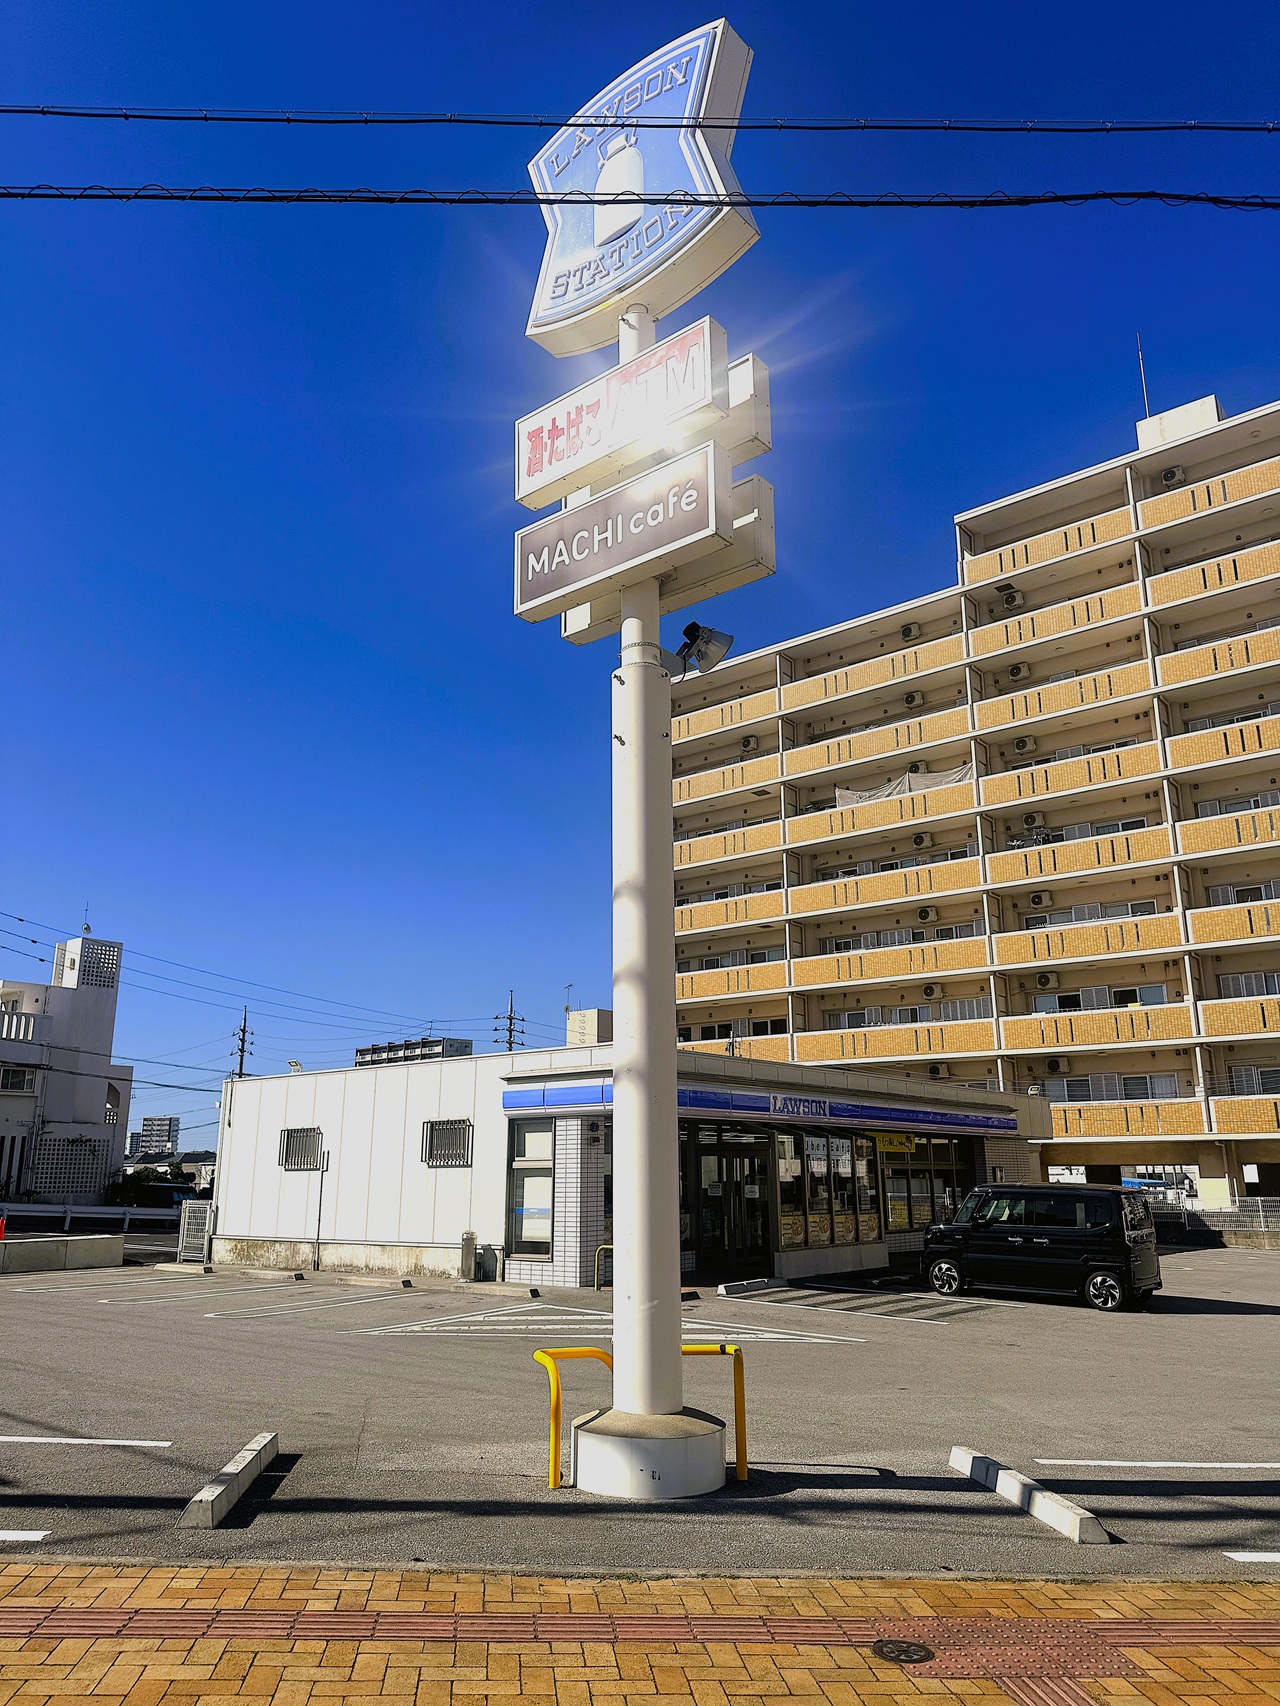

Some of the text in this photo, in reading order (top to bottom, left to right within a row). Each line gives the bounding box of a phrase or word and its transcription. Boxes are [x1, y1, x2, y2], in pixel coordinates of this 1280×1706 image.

[550, 55, 693, 178] LAWSON
[550, 192, 694, 300] STATION
[610, 341, 701, 432] ATM
[527, 479, 699, 581] MACHI café
[772, 1095, 828, 1117] LAWSON
